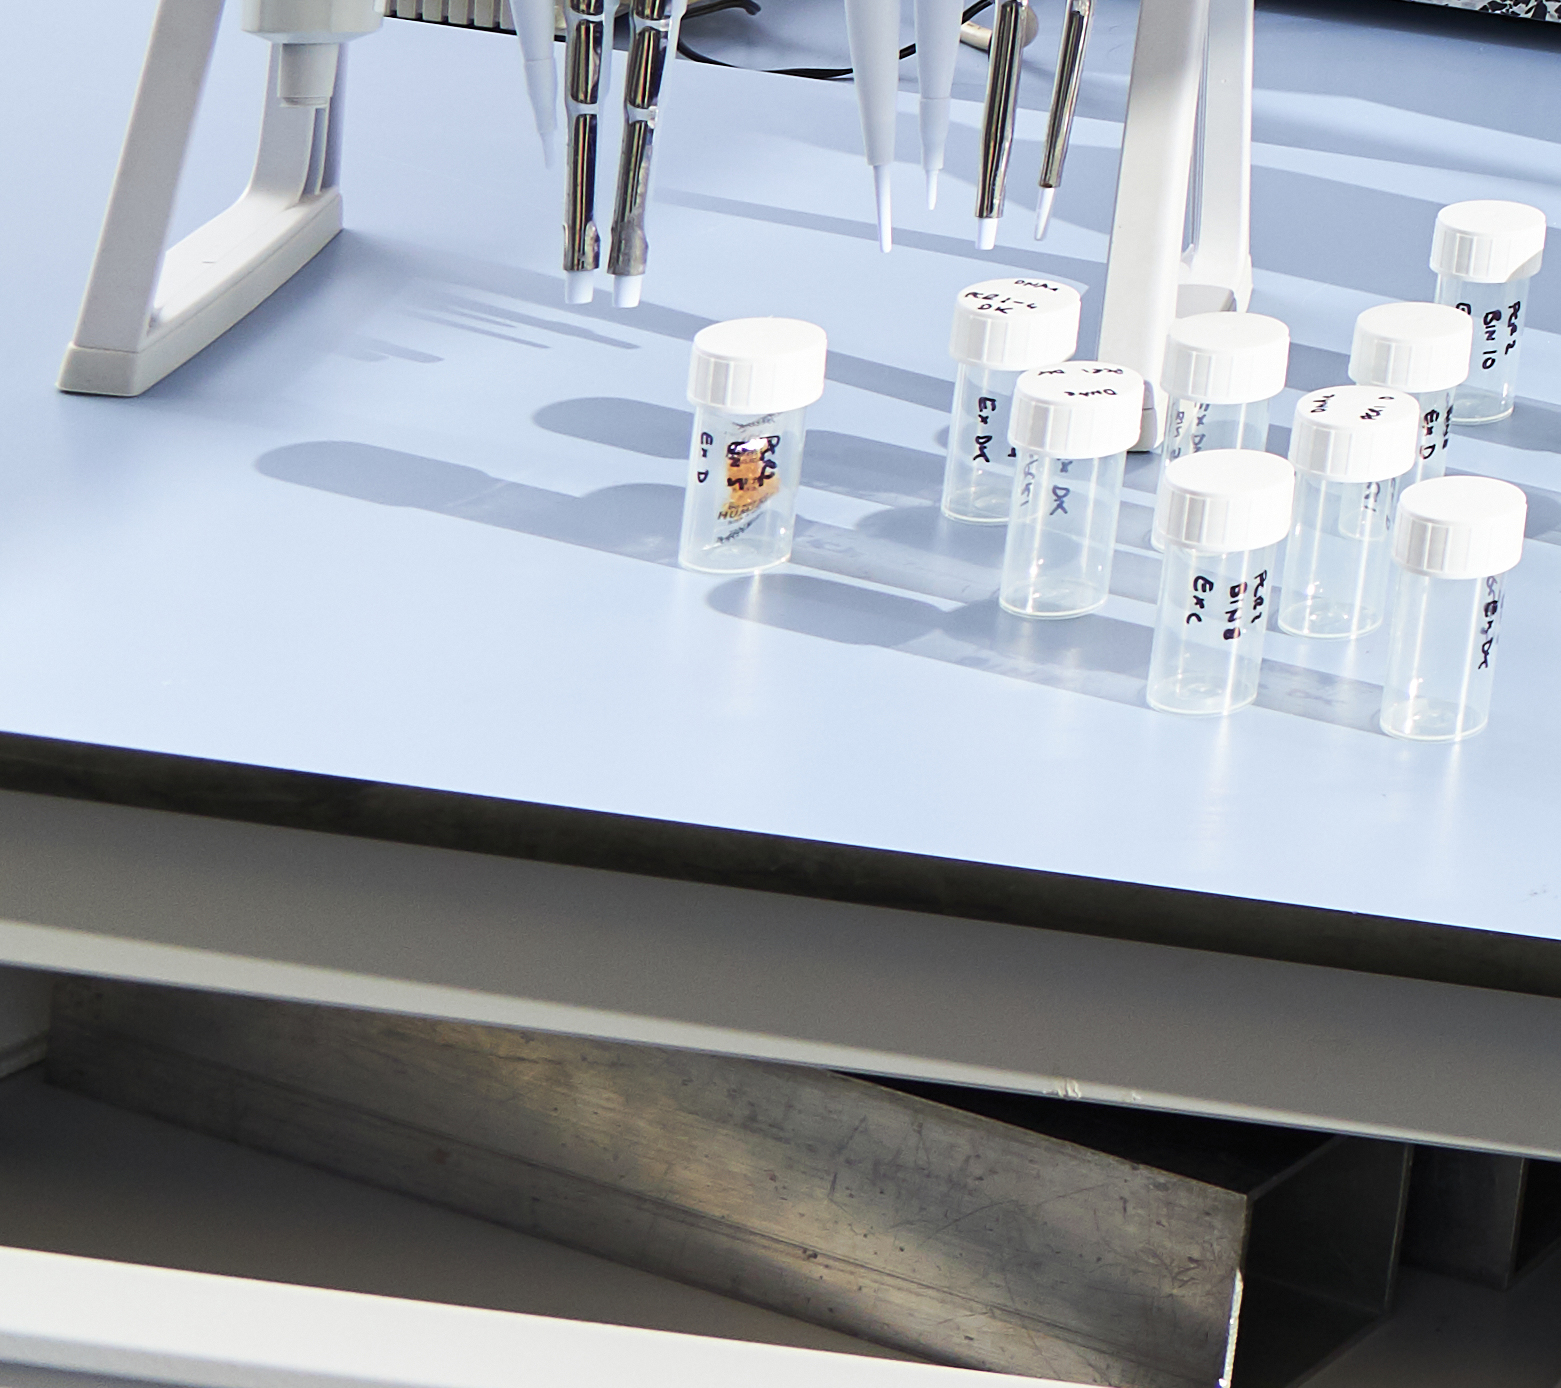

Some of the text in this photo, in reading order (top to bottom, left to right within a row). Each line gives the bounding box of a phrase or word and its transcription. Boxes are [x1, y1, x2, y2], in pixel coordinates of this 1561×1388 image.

[1482, 309, 1502, 369] BIN 10
[973, 397, 997, 463] Ex DK
[1420, 409, 1440, 459] Ex D
[697, 432, 713, 483] Ex D
[1186, 575, 1214, 624] Ex C
[1225, 582, 1247, 622] BIN
